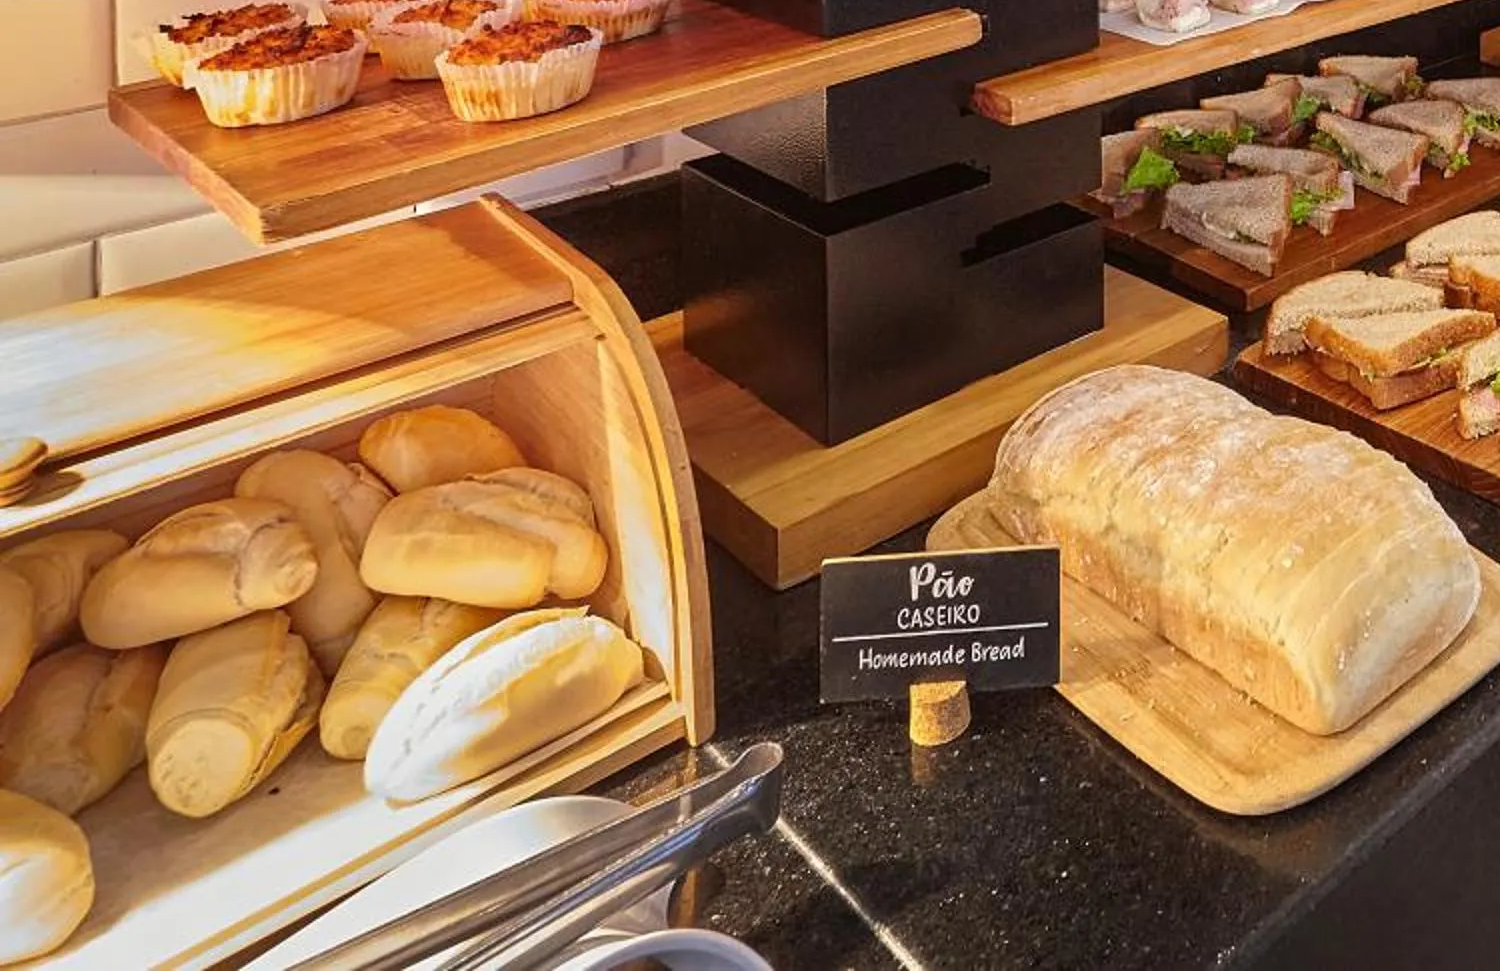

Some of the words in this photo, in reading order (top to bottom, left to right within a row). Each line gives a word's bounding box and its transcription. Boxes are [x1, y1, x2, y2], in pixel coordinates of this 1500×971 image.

[909, 562, 975, 601] Pão
[897, 604, 981, 629] CASEIRO
[859, 644, 966, 670] Homemade
[971, 636, 1026, 663] Bread
